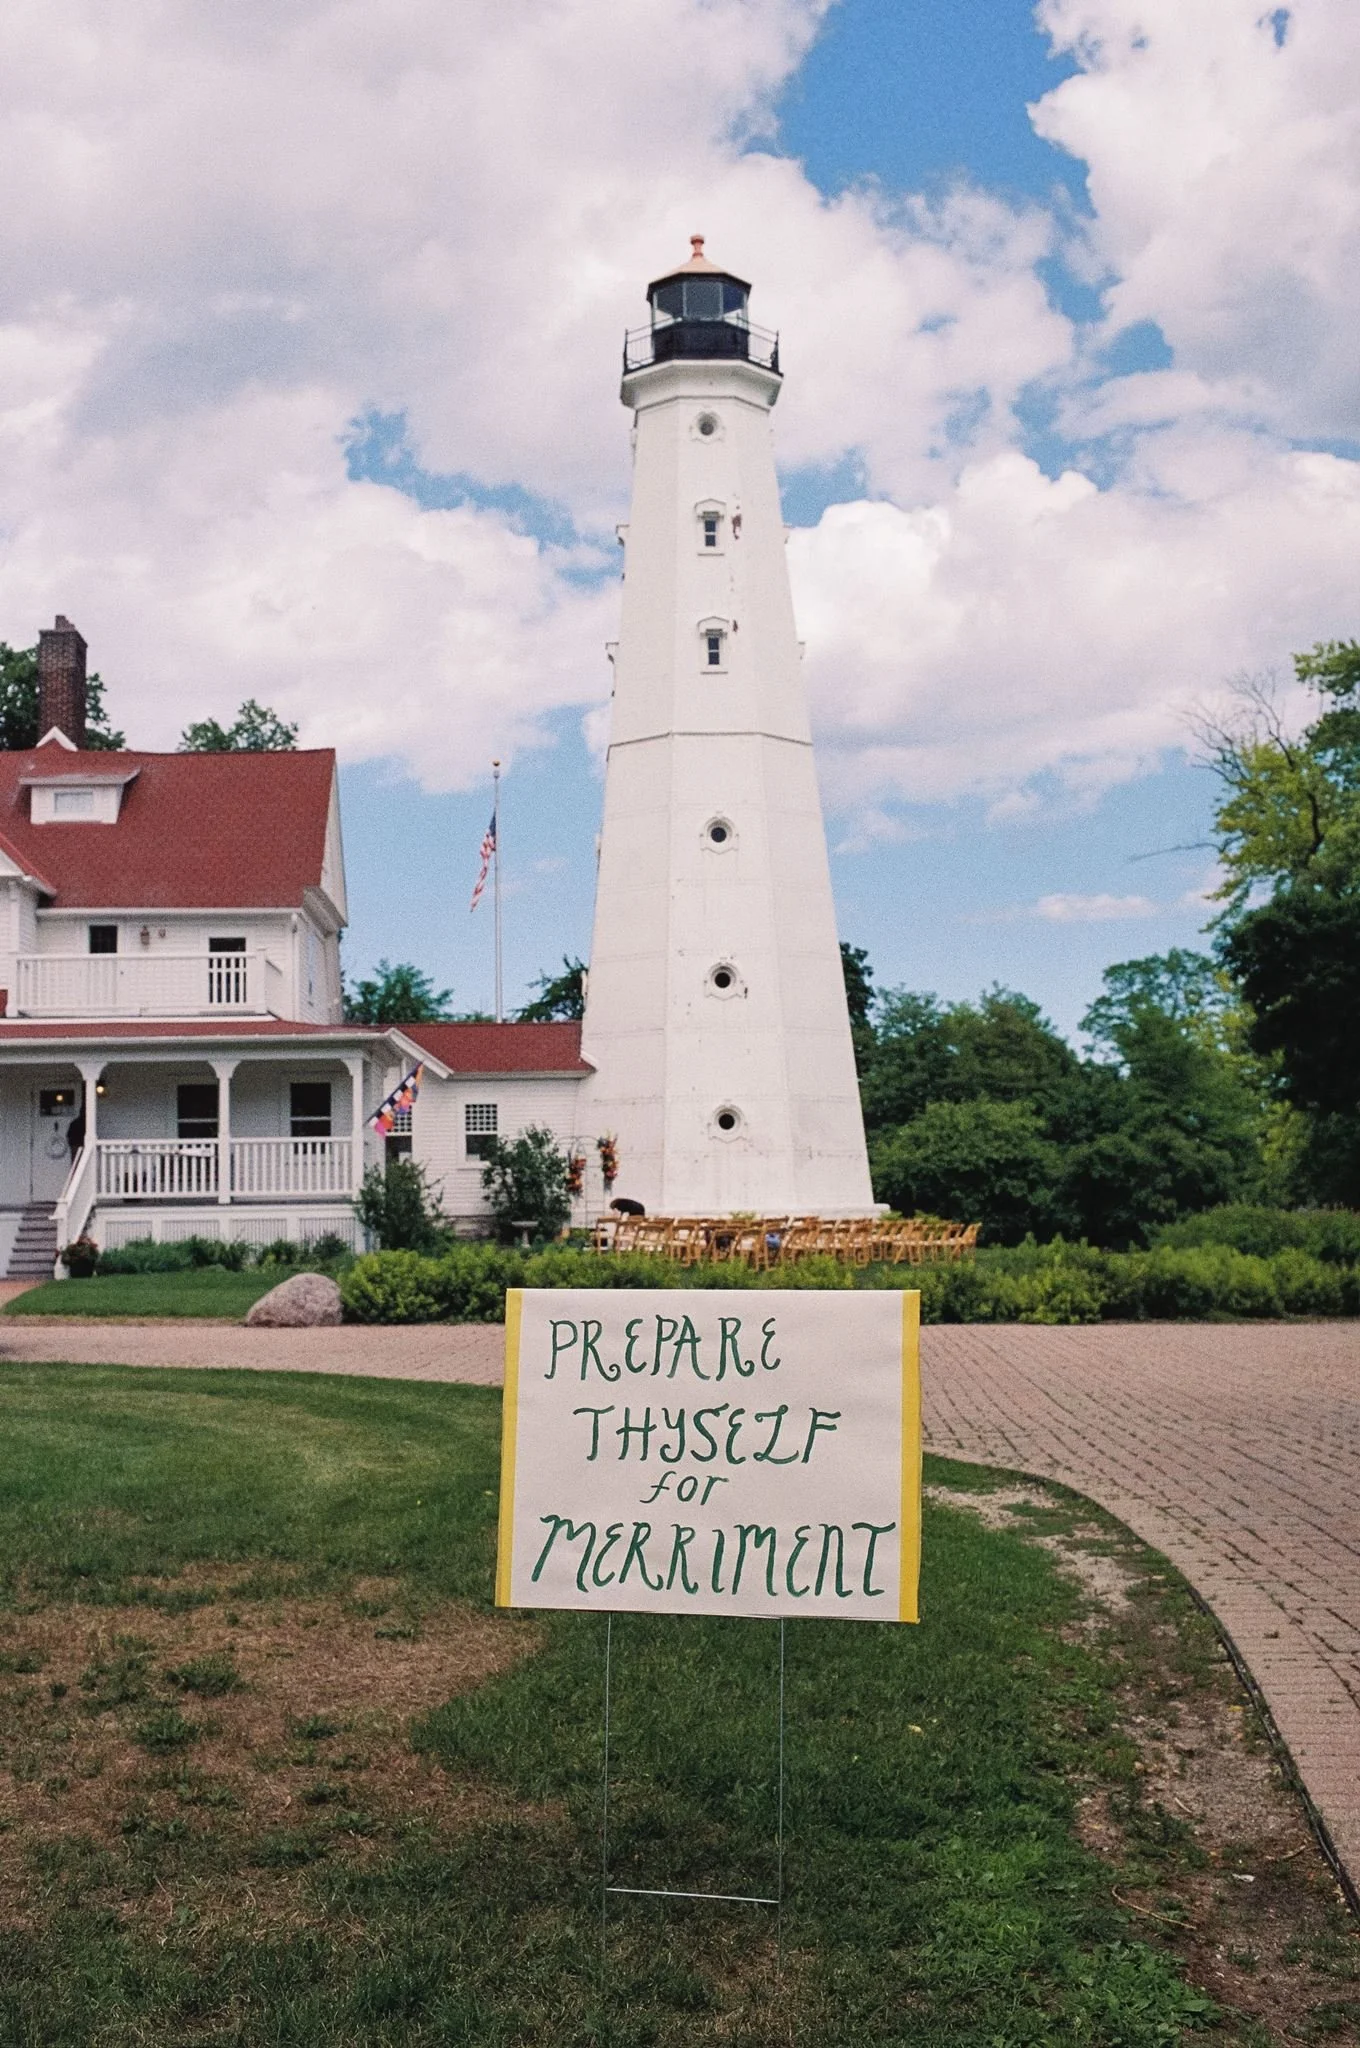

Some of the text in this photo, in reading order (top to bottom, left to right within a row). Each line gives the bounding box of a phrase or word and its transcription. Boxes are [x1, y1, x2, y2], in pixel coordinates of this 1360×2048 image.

[543, 1314, 782, 1382] PREPARE
[572, 1403, 842, 1465] THYSELF
[639, 1471, 730, 1506] for
[531, 1514, 897, 1598] MERRIMENT
